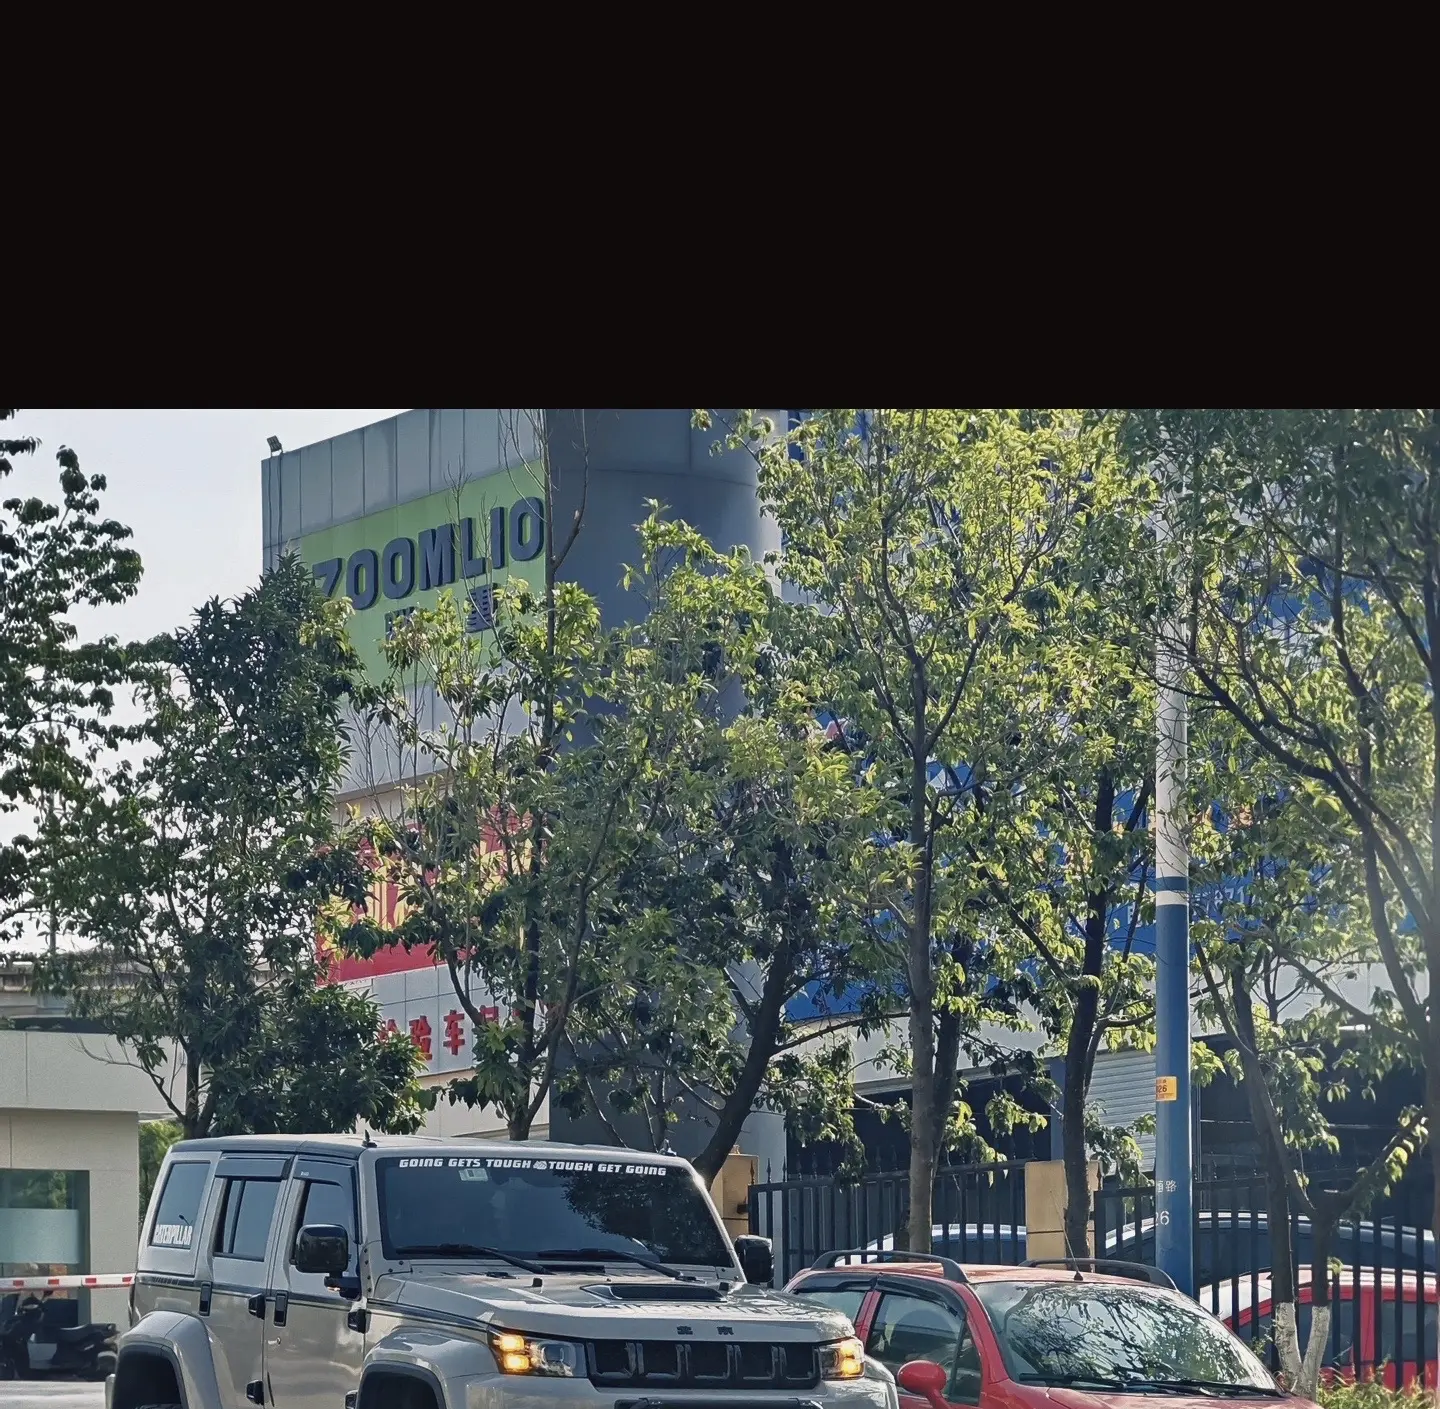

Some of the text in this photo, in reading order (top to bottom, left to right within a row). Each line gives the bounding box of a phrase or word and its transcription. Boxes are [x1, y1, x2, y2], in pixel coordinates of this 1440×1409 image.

[312, 497, 544, 610] ZOOMLIO
[399, 1158, 667, 1176] GOING GETS TOUGH TOUGH GET GOING
